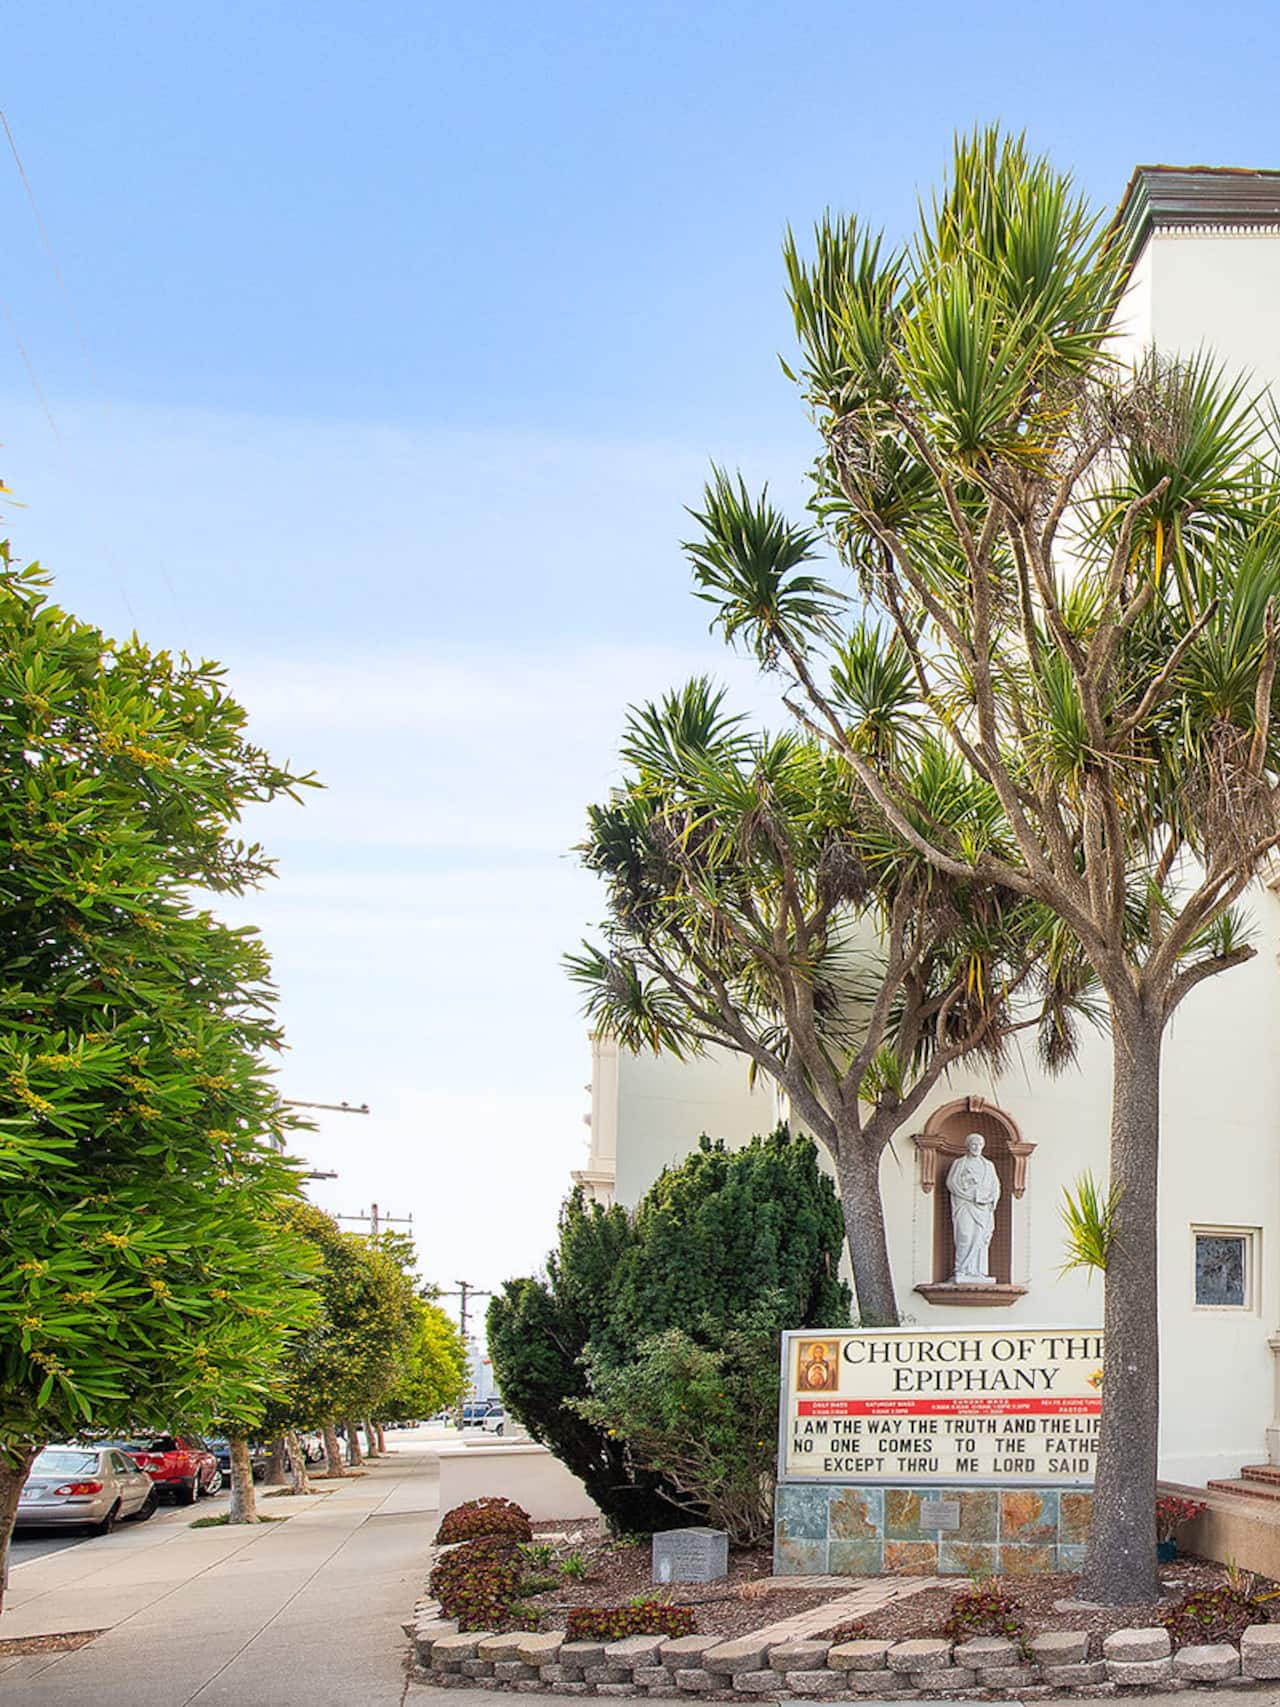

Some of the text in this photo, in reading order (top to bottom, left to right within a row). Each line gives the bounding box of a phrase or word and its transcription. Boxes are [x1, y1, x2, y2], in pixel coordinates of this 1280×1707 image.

[843, 1339, 982, 1363] CHURCH
[991, 1338, 1036, 1361] OF
[892, 1367, 1059, 1392] EPIPHANY
[794, 1418, 1102, 1434] I AM THE WAY THE TRUTH AND THE LIF
[793, 1438, 1101, 1453] NO ONE COMES TO THE FATHE
[823, 1458, 1090, 1472] EXCEPT THRU ME LORD SAID
